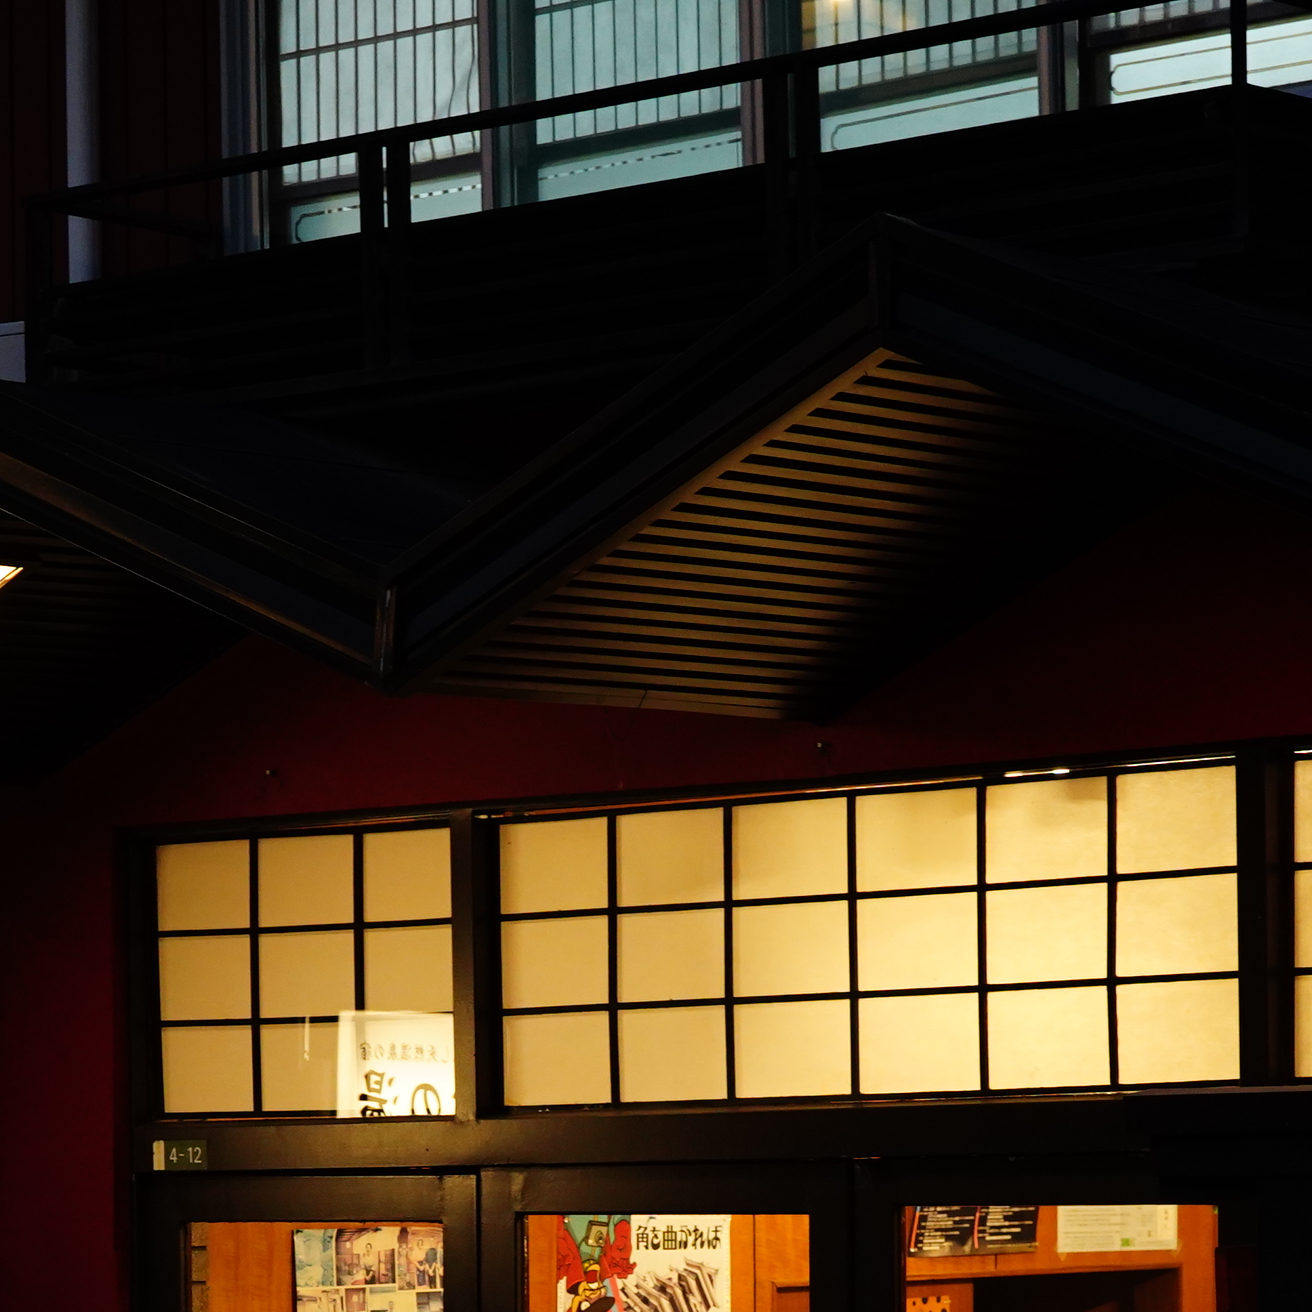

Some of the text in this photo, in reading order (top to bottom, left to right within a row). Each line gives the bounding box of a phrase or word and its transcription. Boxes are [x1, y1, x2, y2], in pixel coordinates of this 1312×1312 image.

[169, 1147, 202, 1164] 4-12
[636, 1225, 723, 1250] 角を曲がれば
